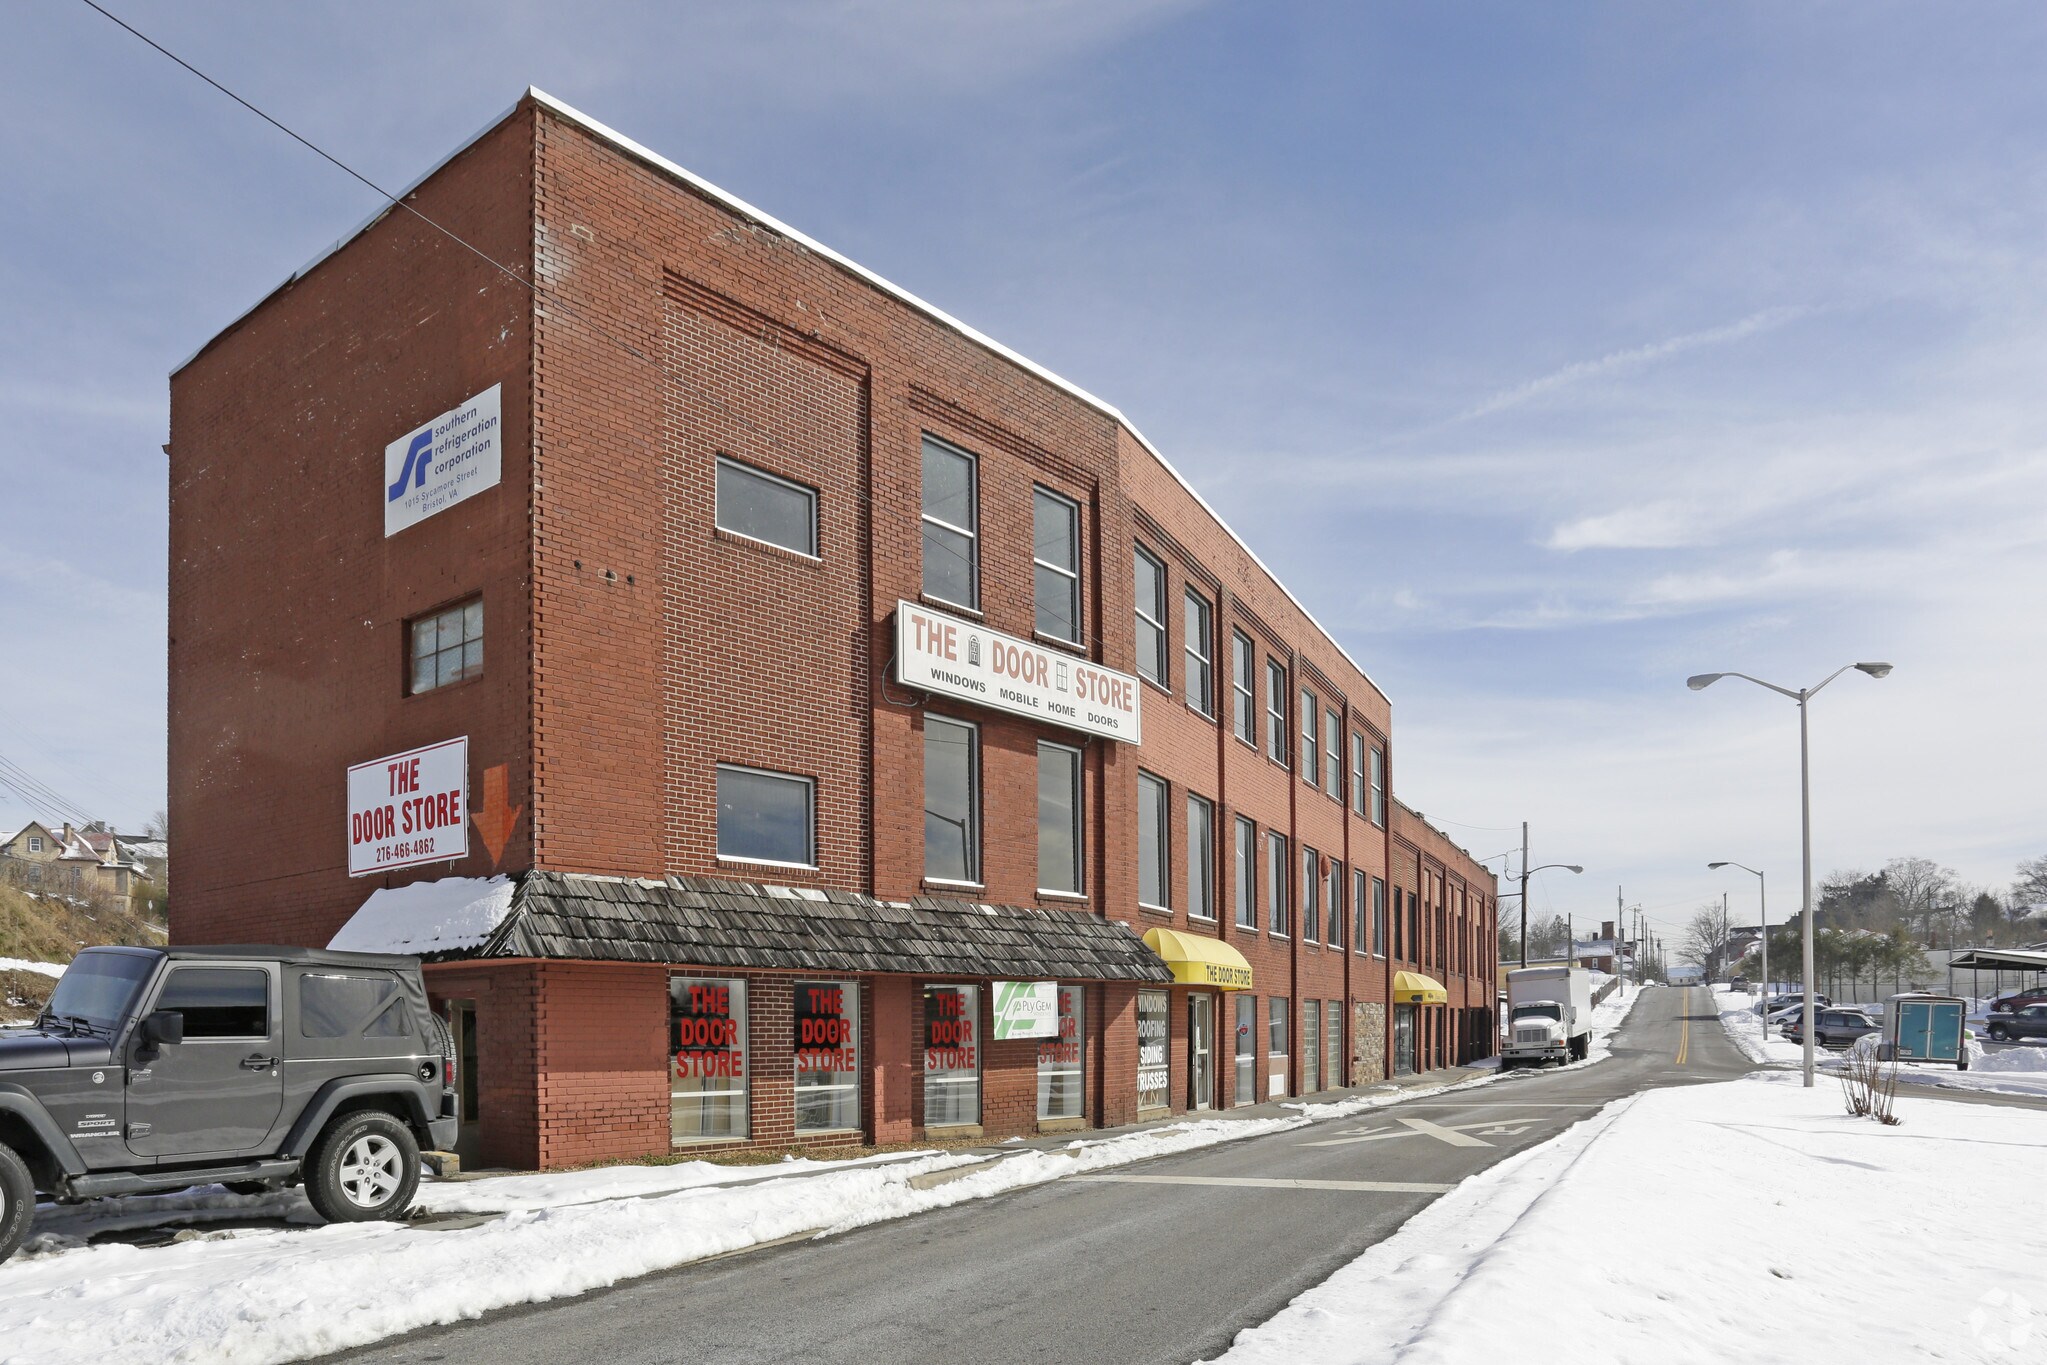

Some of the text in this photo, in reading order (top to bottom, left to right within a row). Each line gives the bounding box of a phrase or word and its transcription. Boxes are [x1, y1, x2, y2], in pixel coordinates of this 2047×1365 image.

[435, 407, 477, 438] southern
[434, 416, 497, 456] refrigeration
[434, 439, 491, 475] corporation
[404, 466, 478, 509] 1015 Sycamore Street
[422, 490, 458, 513] Bristol, VA
[911, 614, 1133, 713] THE DOOR STORE
[931, 668, 1119, 729] WINDOWS MOBILE HOME DOORS
[388, 758, 420, 797] THE
[353, 790, 460, 845] DOOR STORE
[1206, 965, 1250, 985] THE DOOR STORE
[688, 986, 729, 1014] THE
[808, 989, 843, 1014] THE
[936, 993, 965, 1016] THE
[1058, 993, 1071, 1013] HE
[681, 1019, 738, 1046] DOOR
[802, 1019, 850, 1044] DOOR
[931, 1020, 972, 1044] DOOR
[1060, 1018, 1076, 1038] OR
[676, 1051, 742, 1079] STORE
[798, 1047, 855, 1073] STORE
[928, 1046, 975, 1070] STORE
[1039, 1043, 1079, 1064] STORE
[1140, 1046, 1163, 1064] SIDING
[70, 1131, 120, 1139] WRANGLER
